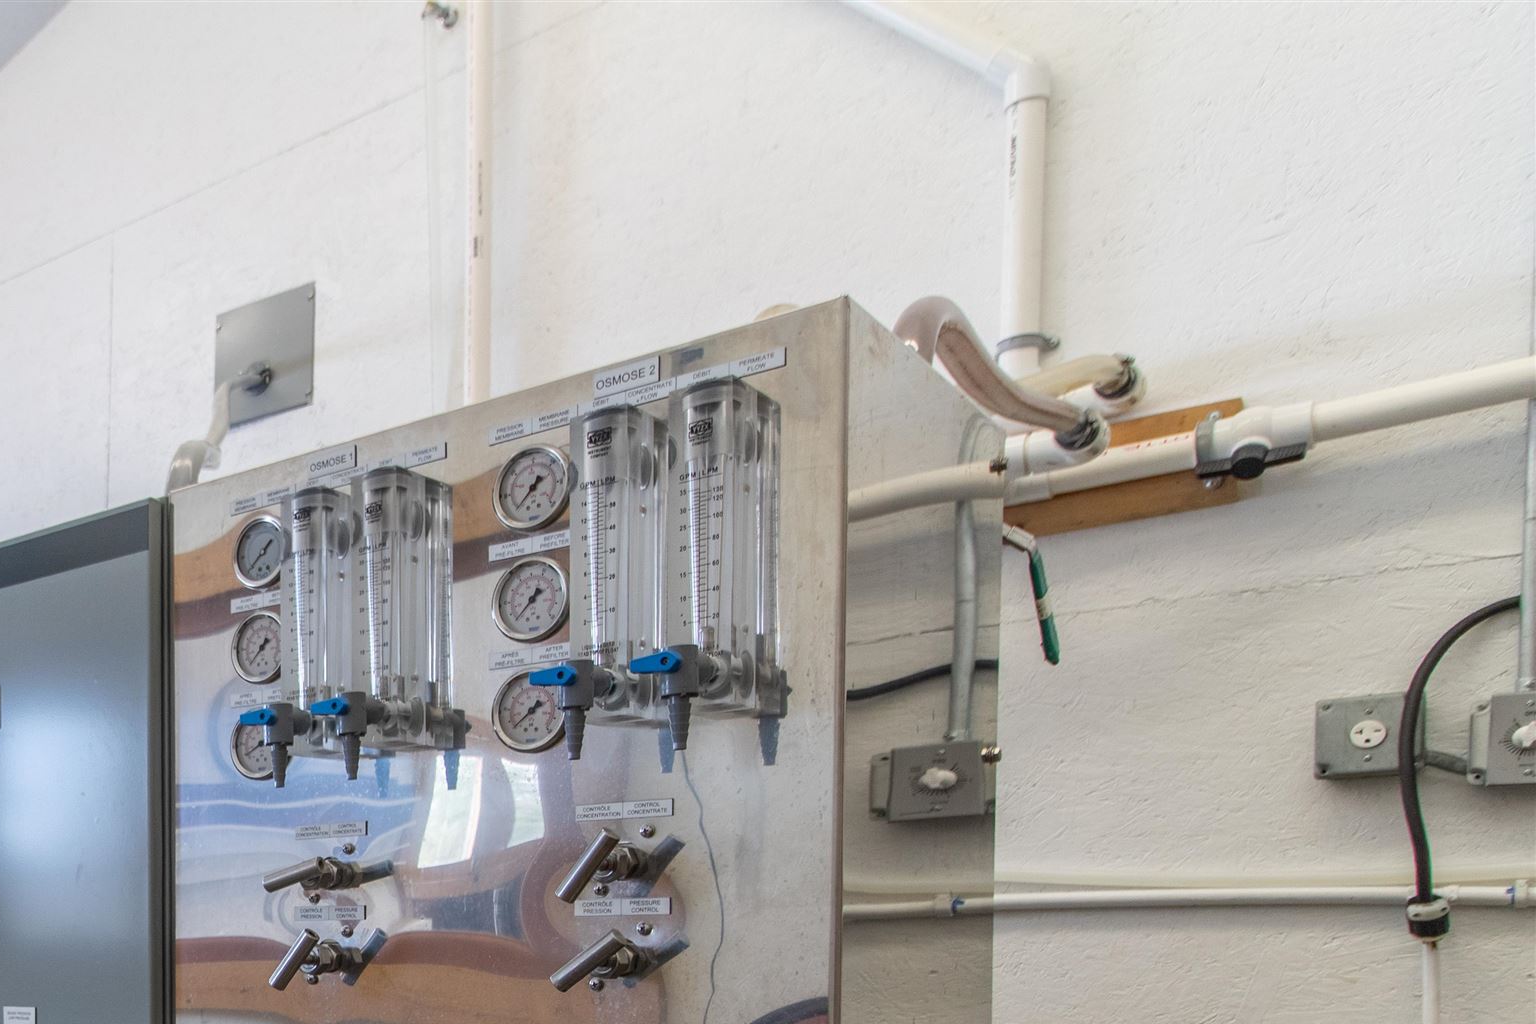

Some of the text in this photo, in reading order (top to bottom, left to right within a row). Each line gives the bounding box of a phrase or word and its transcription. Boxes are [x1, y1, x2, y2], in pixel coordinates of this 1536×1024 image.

[739, 352, 775, 367] PERMEATE
[747, 362, 766, 372] FLOW
[596, 364, 656, 390] OSMOSE 2
[627, 381, 672, 398] CONCENTRATE
[640, 391, 658, 402] FLOW
[538, 409, 570, 422] MEMBRANE
[496, 422, 524, 434] PRESSION
[539, 416, 570, 429] PRESSURE
[495, 429, 525, 441] MEMBRANE
[310, 453, 354, 472] OSMOSE 1
[679, 466, 718, 481] GPM LPM
[502, 541, 519, 550] AVANT
[539, 538, 570, 550] PREFILTER
[545, 645, 563, 653] AFTER
[539, 651, 569, 660] PREFILTER
